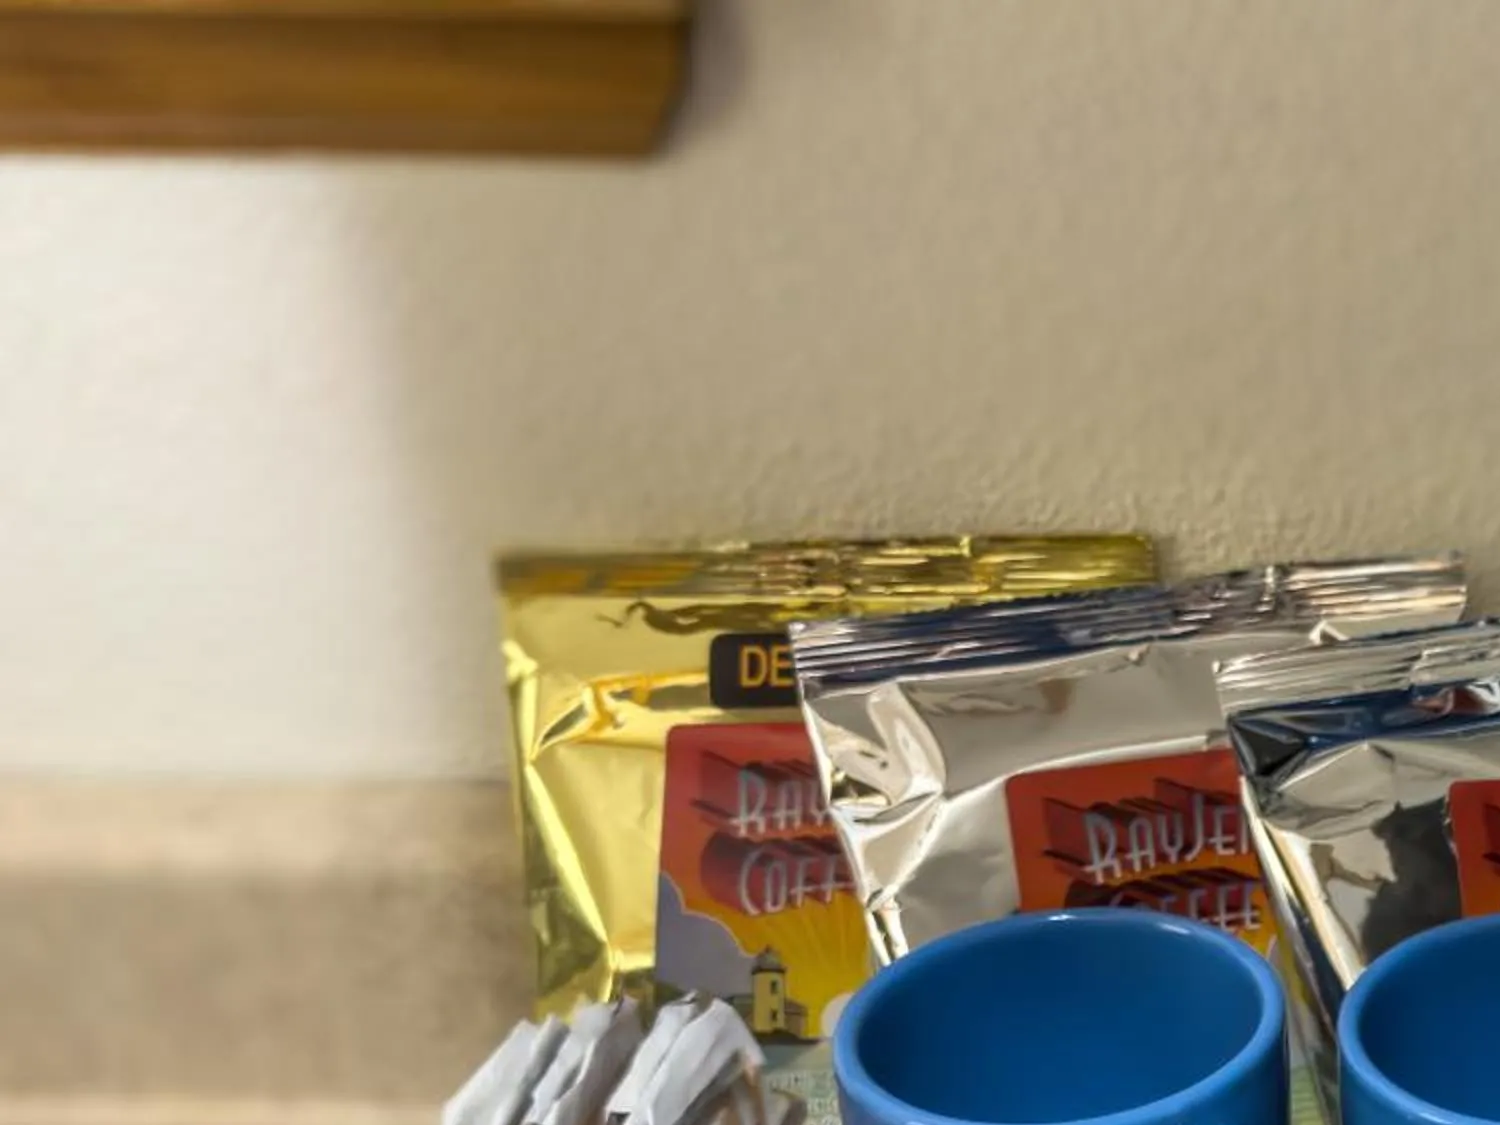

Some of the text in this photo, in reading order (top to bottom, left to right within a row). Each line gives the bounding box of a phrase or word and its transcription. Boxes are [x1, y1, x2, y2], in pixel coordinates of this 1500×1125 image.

[739, 643, 794, 688] DE
[730, 767, 832, 837] RAY
[739, 848, 857, 916] COFF
